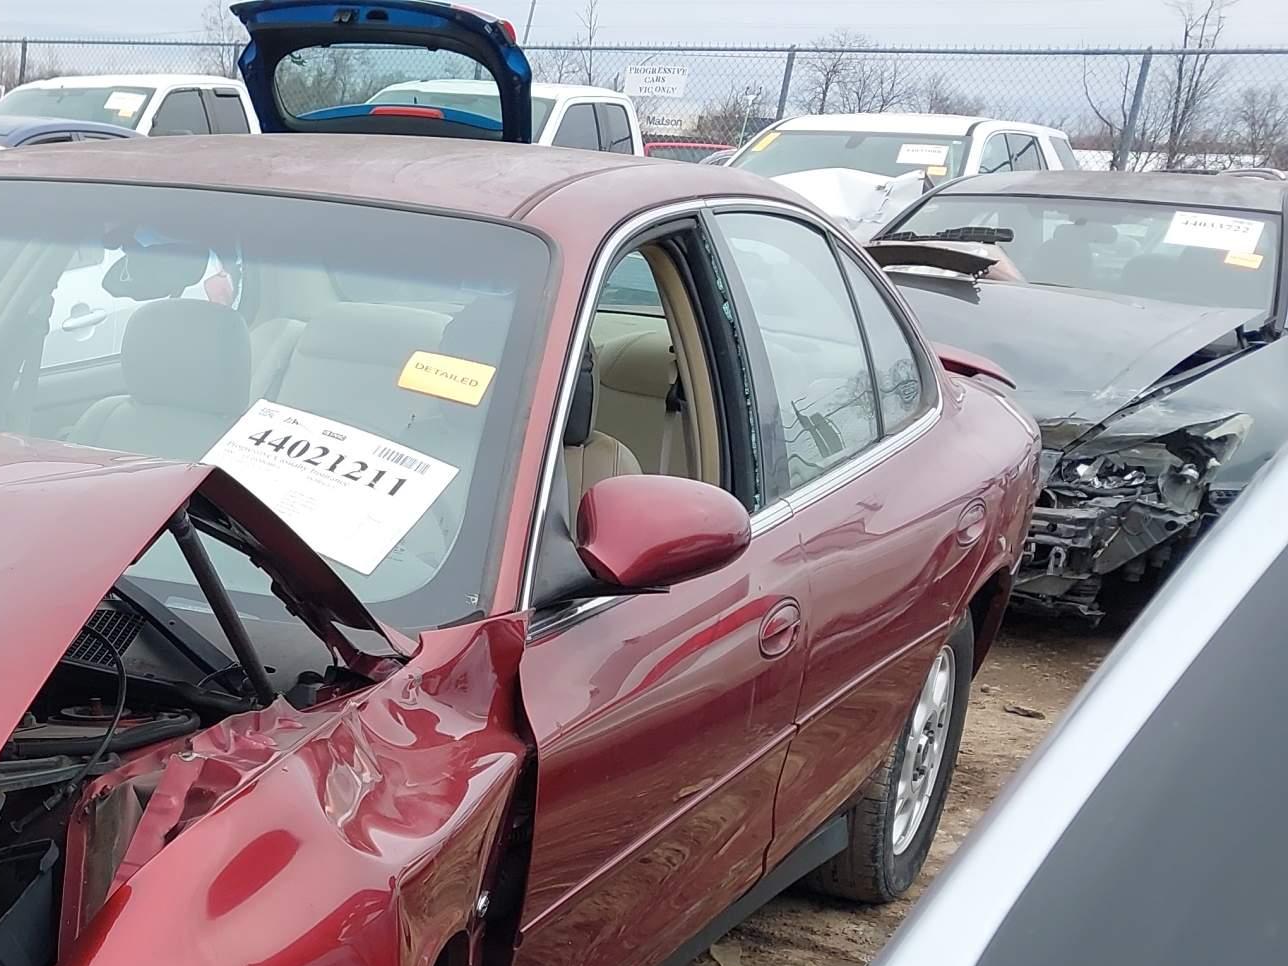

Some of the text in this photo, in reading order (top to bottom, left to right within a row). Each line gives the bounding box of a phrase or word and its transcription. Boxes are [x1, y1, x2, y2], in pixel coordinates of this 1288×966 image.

[629, 66, 688, 75] PROGRESSIVE
[644, 76, 666, 84] CARS
[654, 86, 677, 94] ONLY
[646, 115, 682, 127] Matson
[415, 361, 479, 388] DETAILED
[248, 429, 408, 497] 44021211
